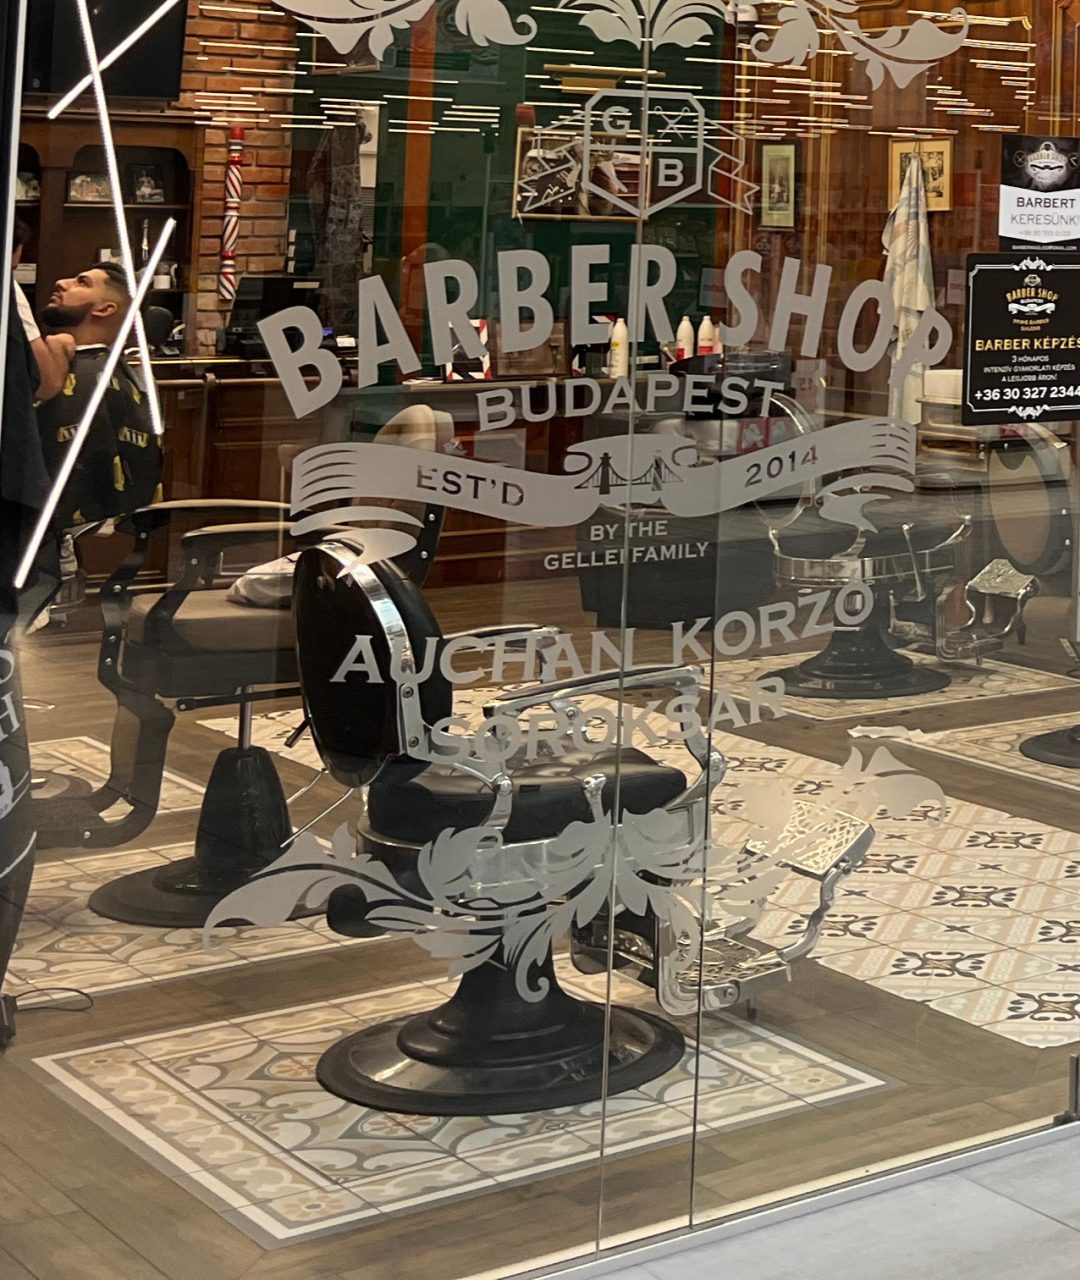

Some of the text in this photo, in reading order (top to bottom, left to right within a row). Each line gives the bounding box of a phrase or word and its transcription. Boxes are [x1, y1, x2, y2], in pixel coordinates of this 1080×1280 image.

[603, 106, 630, 135] G
[657, 158, 684, 187] B
[1016, 197, 1076, 209] BARBERT
[1005, 288, 1058, 302] BARBER SHOP
[256, 244, 953, 418] BARBER SHOP
[975, 339, 1031, 351] BARBER
[475, 373, 784, 432] BUDAPEST
[975, 389, 1000, 401] +36
[1003, 388, 1020, 400] 30
[1022, 387, 1047, 399] 327
[416, 444, 818, 506] EST'D 2014
[590, 520, 668, 541] BY THE
[631, 540, 710, 565] FAMILY
[330, 627, 636, 684] AUCHAN
